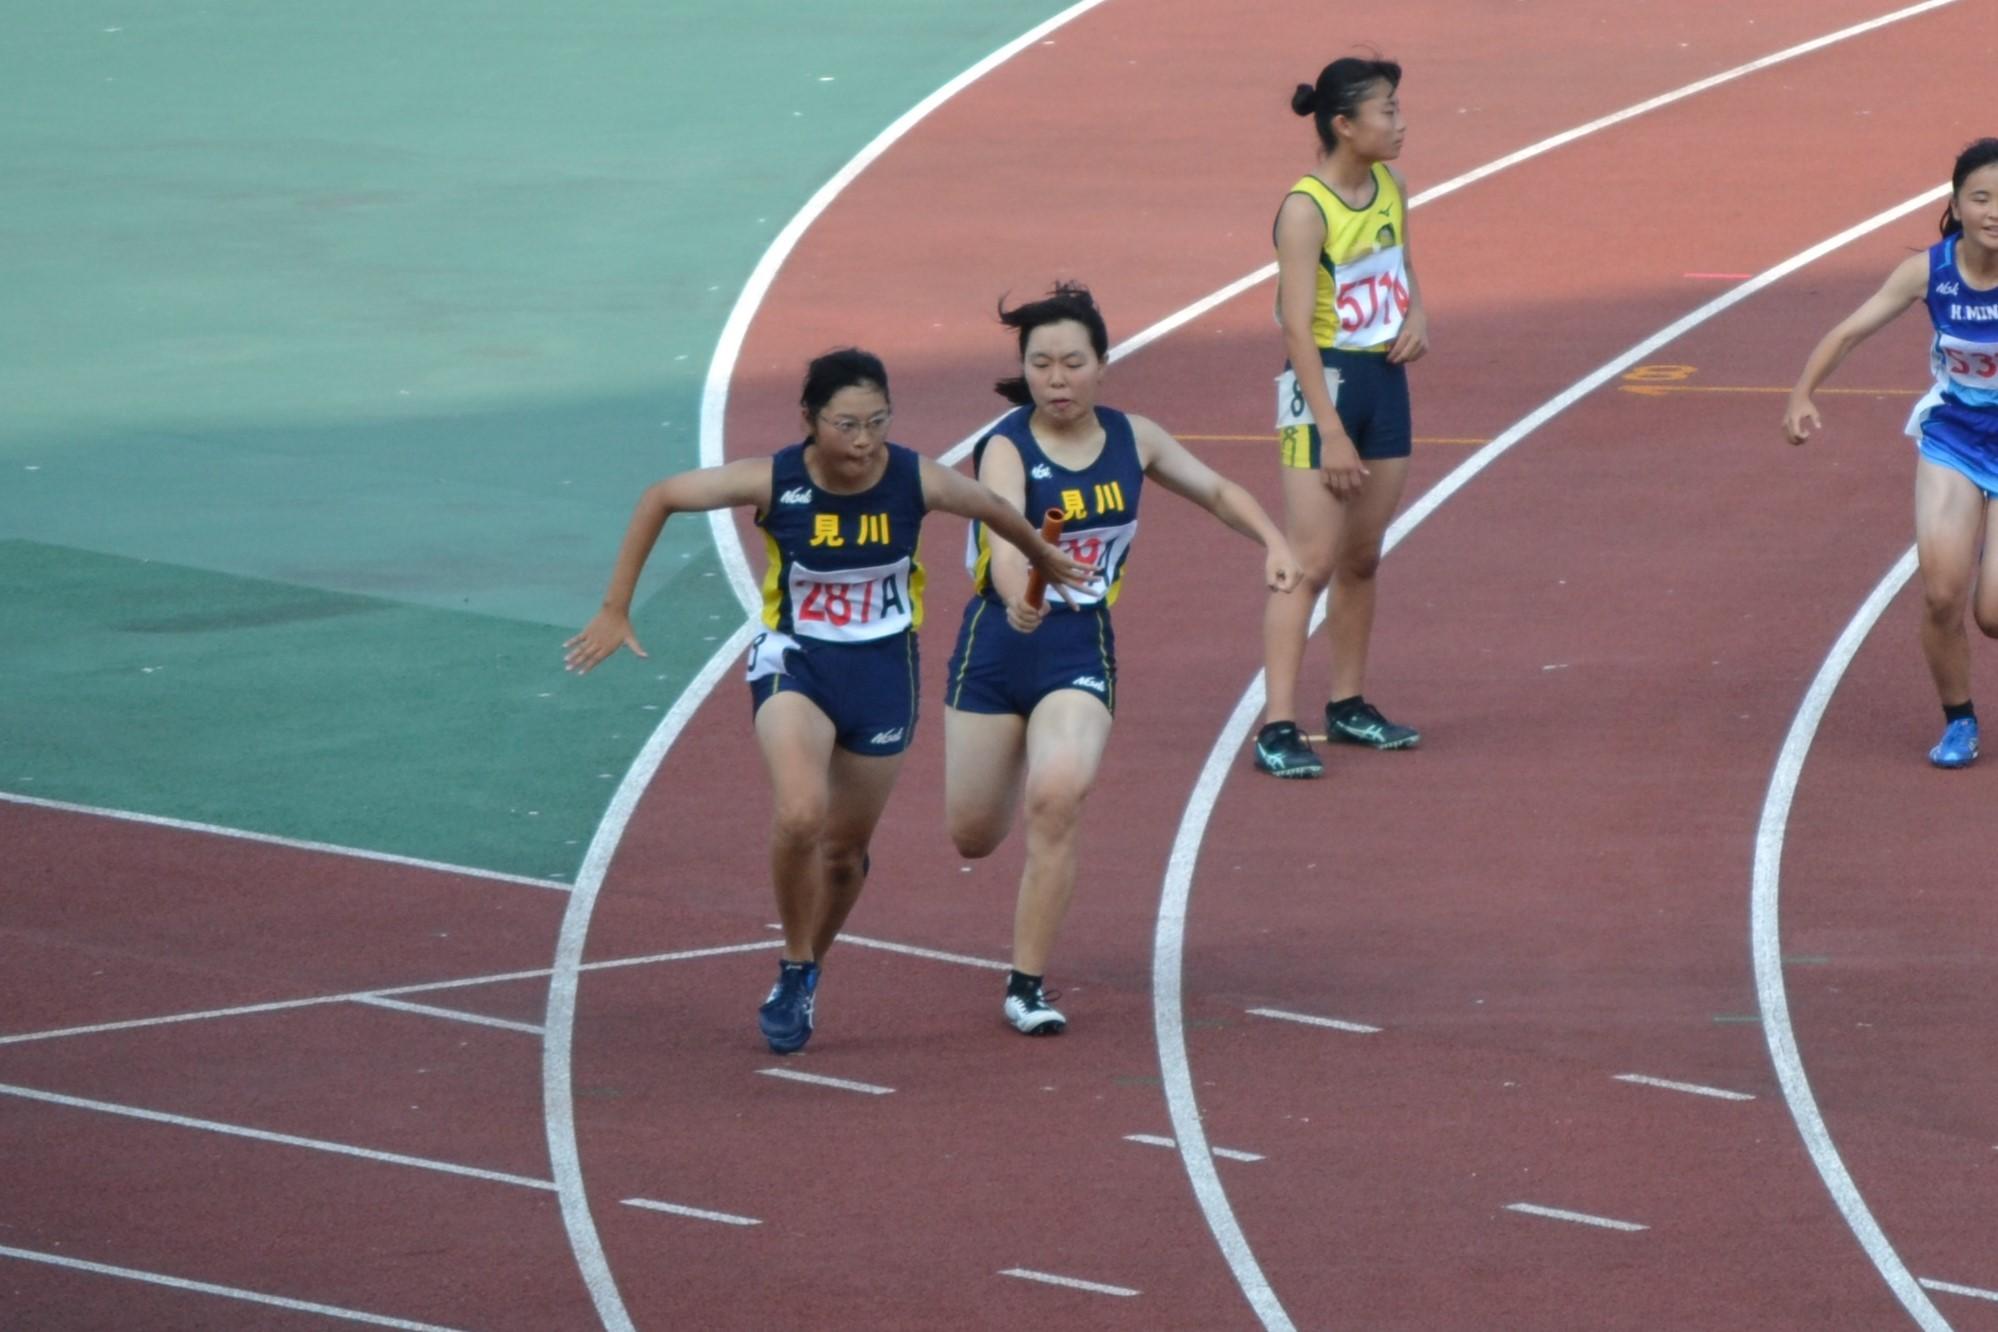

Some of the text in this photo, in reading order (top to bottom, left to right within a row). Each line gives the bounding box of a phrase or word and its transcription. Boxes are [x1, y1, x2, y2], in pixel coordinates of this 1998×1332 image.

[1944, 347, 1998, 379] 53
[1060, 480, 1125, 521] 見川
[809, 513, 890, 547] 見川
